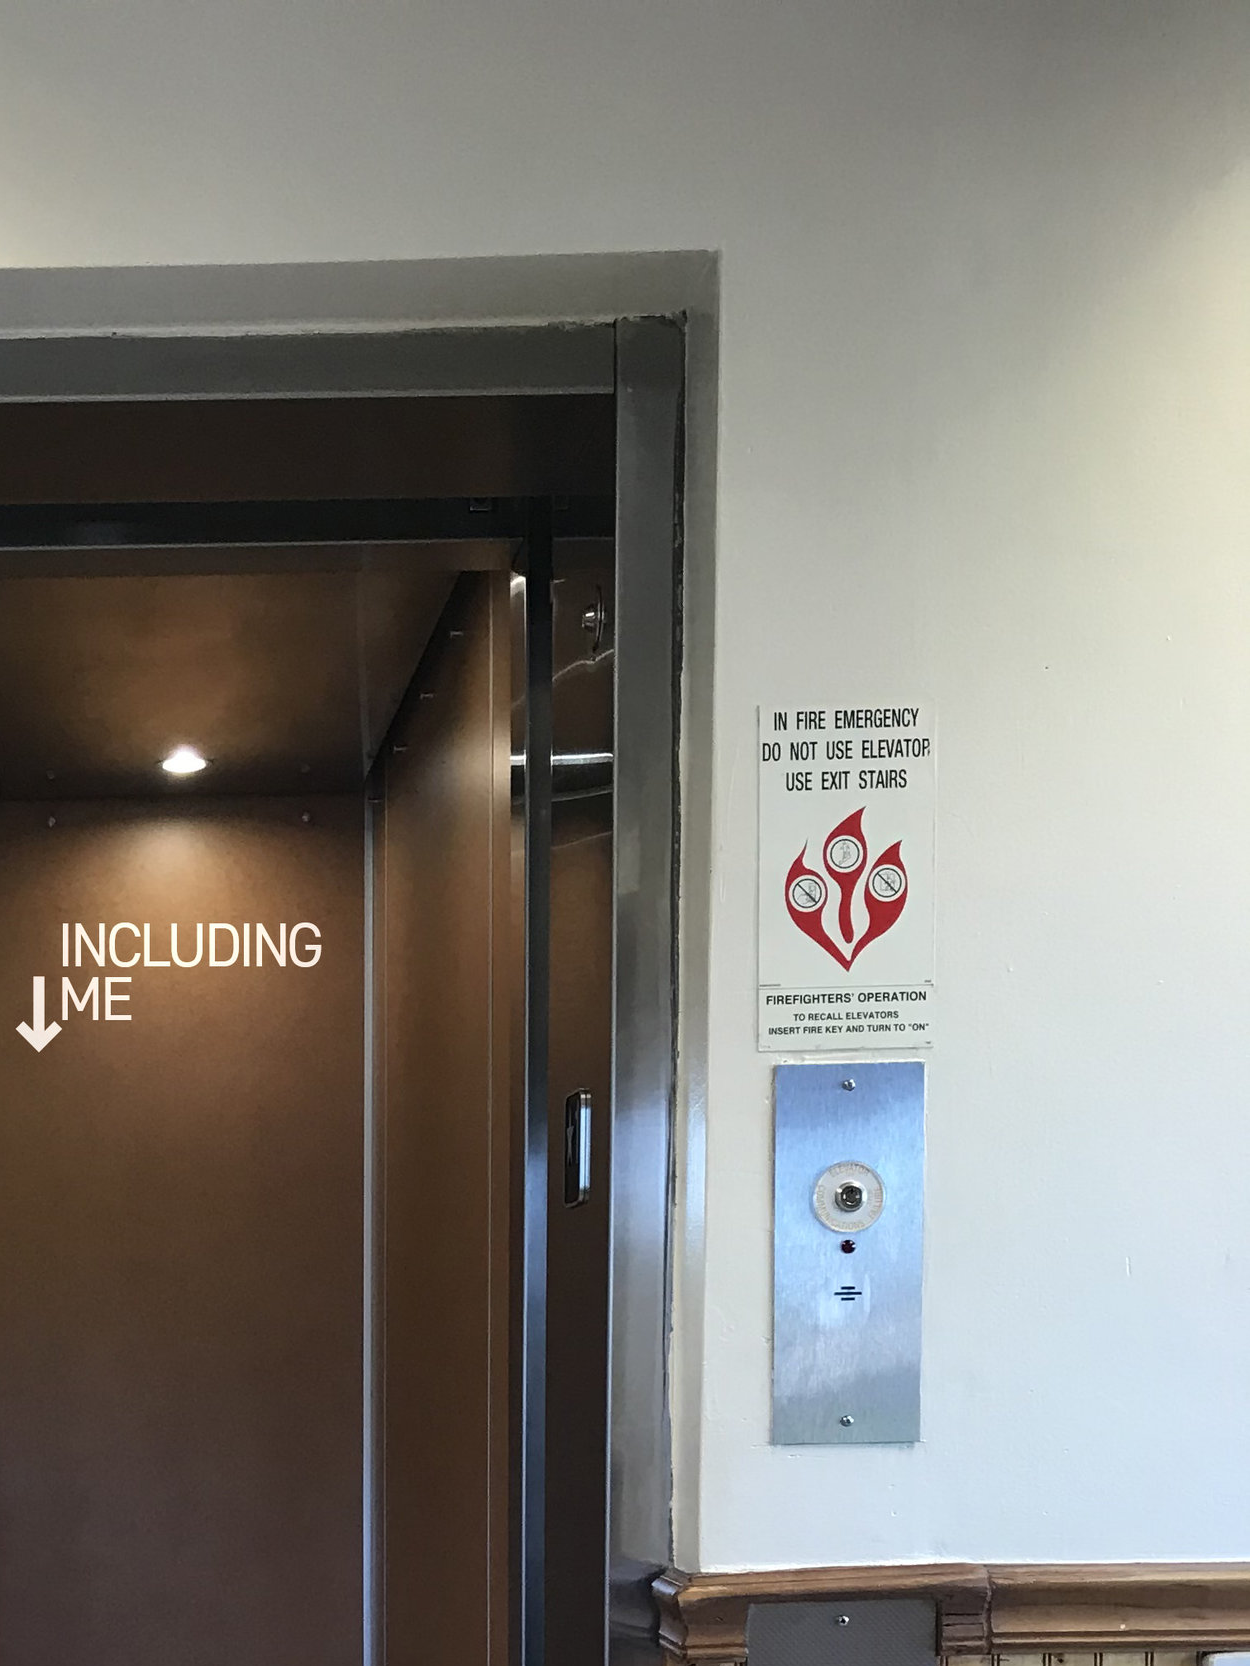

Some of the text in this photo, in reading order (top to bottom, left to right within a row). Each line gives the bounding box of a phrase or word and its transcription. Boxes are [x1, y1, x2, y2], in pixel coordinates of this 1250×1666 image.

[774, 708, 919, 730] IN FIRE EMERGENCY
[763, 743, 781, 761] DO
[790, 742, 817, 760] NOT
[827, 741, 853, 760] USE
[786, 769, 907, 791] USE EXIT STAIRS
[63, 922, 321, 967] INCLUDING
[62, 977, 132, 1020] ME
[858, 991, 926, 1002] OPERATION
[793, 1013, 805, 1021] TO
[846, 1011, 899, 1020] ELEVATORS
[769, 1027, 800, 1035] INSERT
[867, 1024, 891, 1032] TURN
